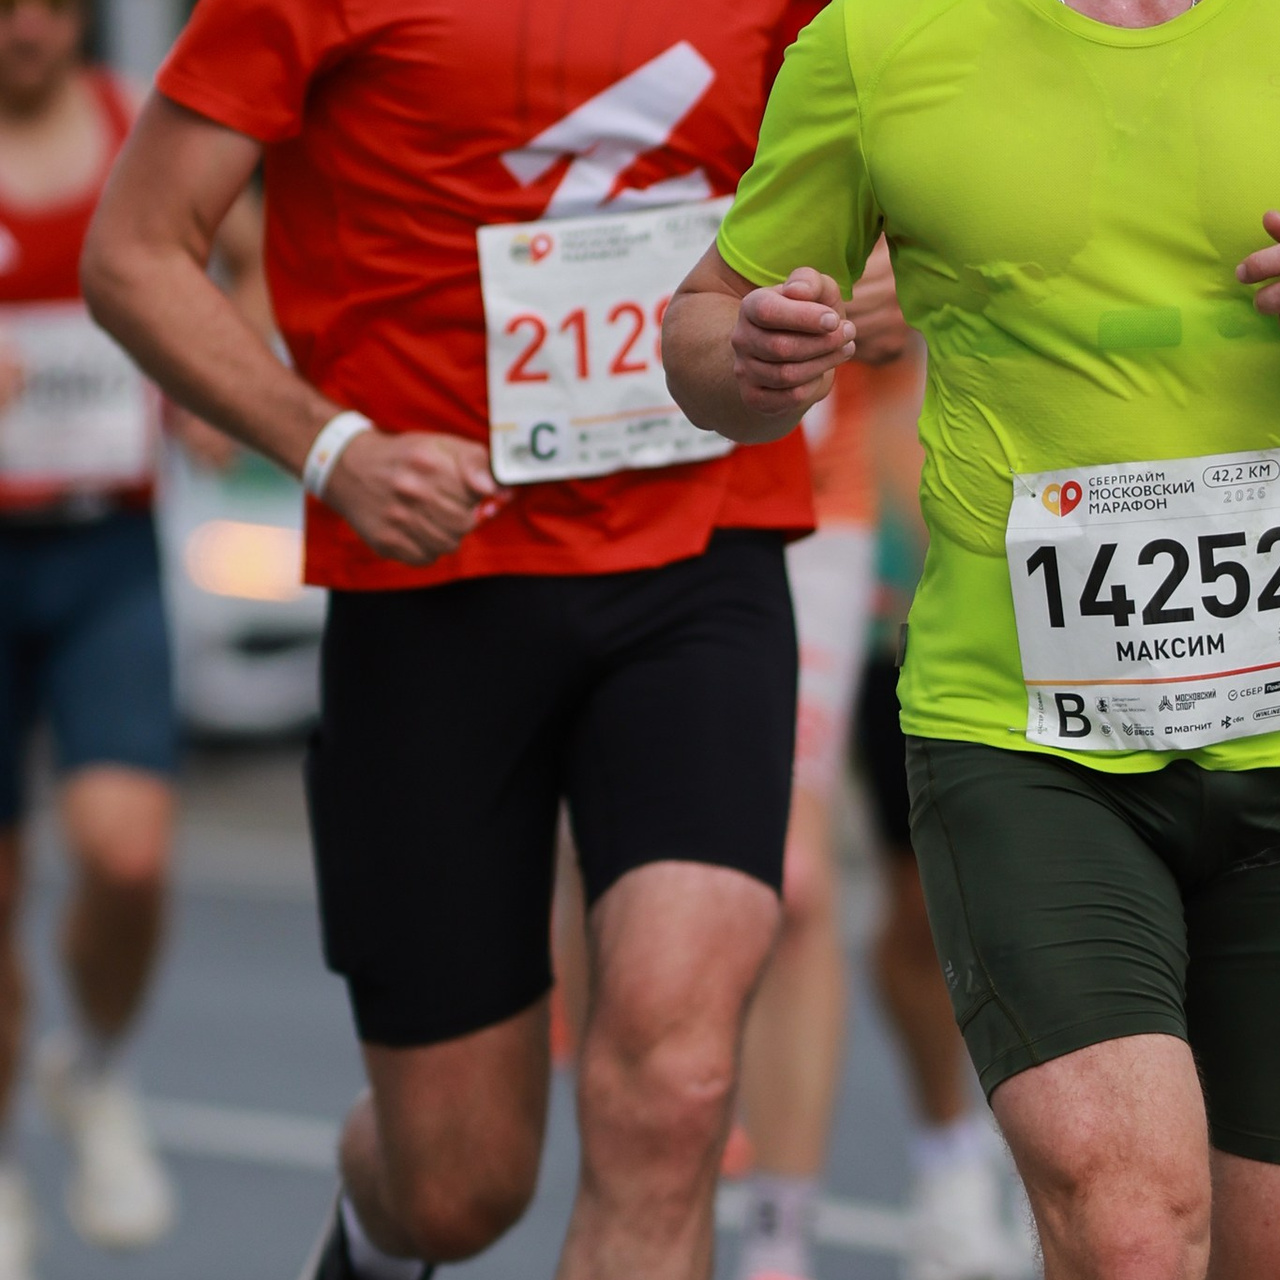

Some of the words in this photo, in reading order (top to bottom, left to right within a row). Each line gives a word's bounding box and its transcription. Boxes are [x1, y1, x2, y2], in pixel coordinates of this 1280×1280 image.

[1088, 471, 1166, 487] СБЕРПРАЙМ
[1211, 467, 1243, 483] 42,2
[1249, 464, 1271, 479] КМ
[1088, 480, 1196, 501] МОСКОВСКИЙ
[1088, 497, 1168, 515] МАРАФОН
[1116, 632, 1225, 662] МАКСИМ
[1174, 688, 1217, 702] МОСКОВСКИЙ
[1240, 686, 1264, 698] СБЕР
[1175, 701, 1196, 711] СПОРТ
[1255, 708, 1280, 718] WINLINE
